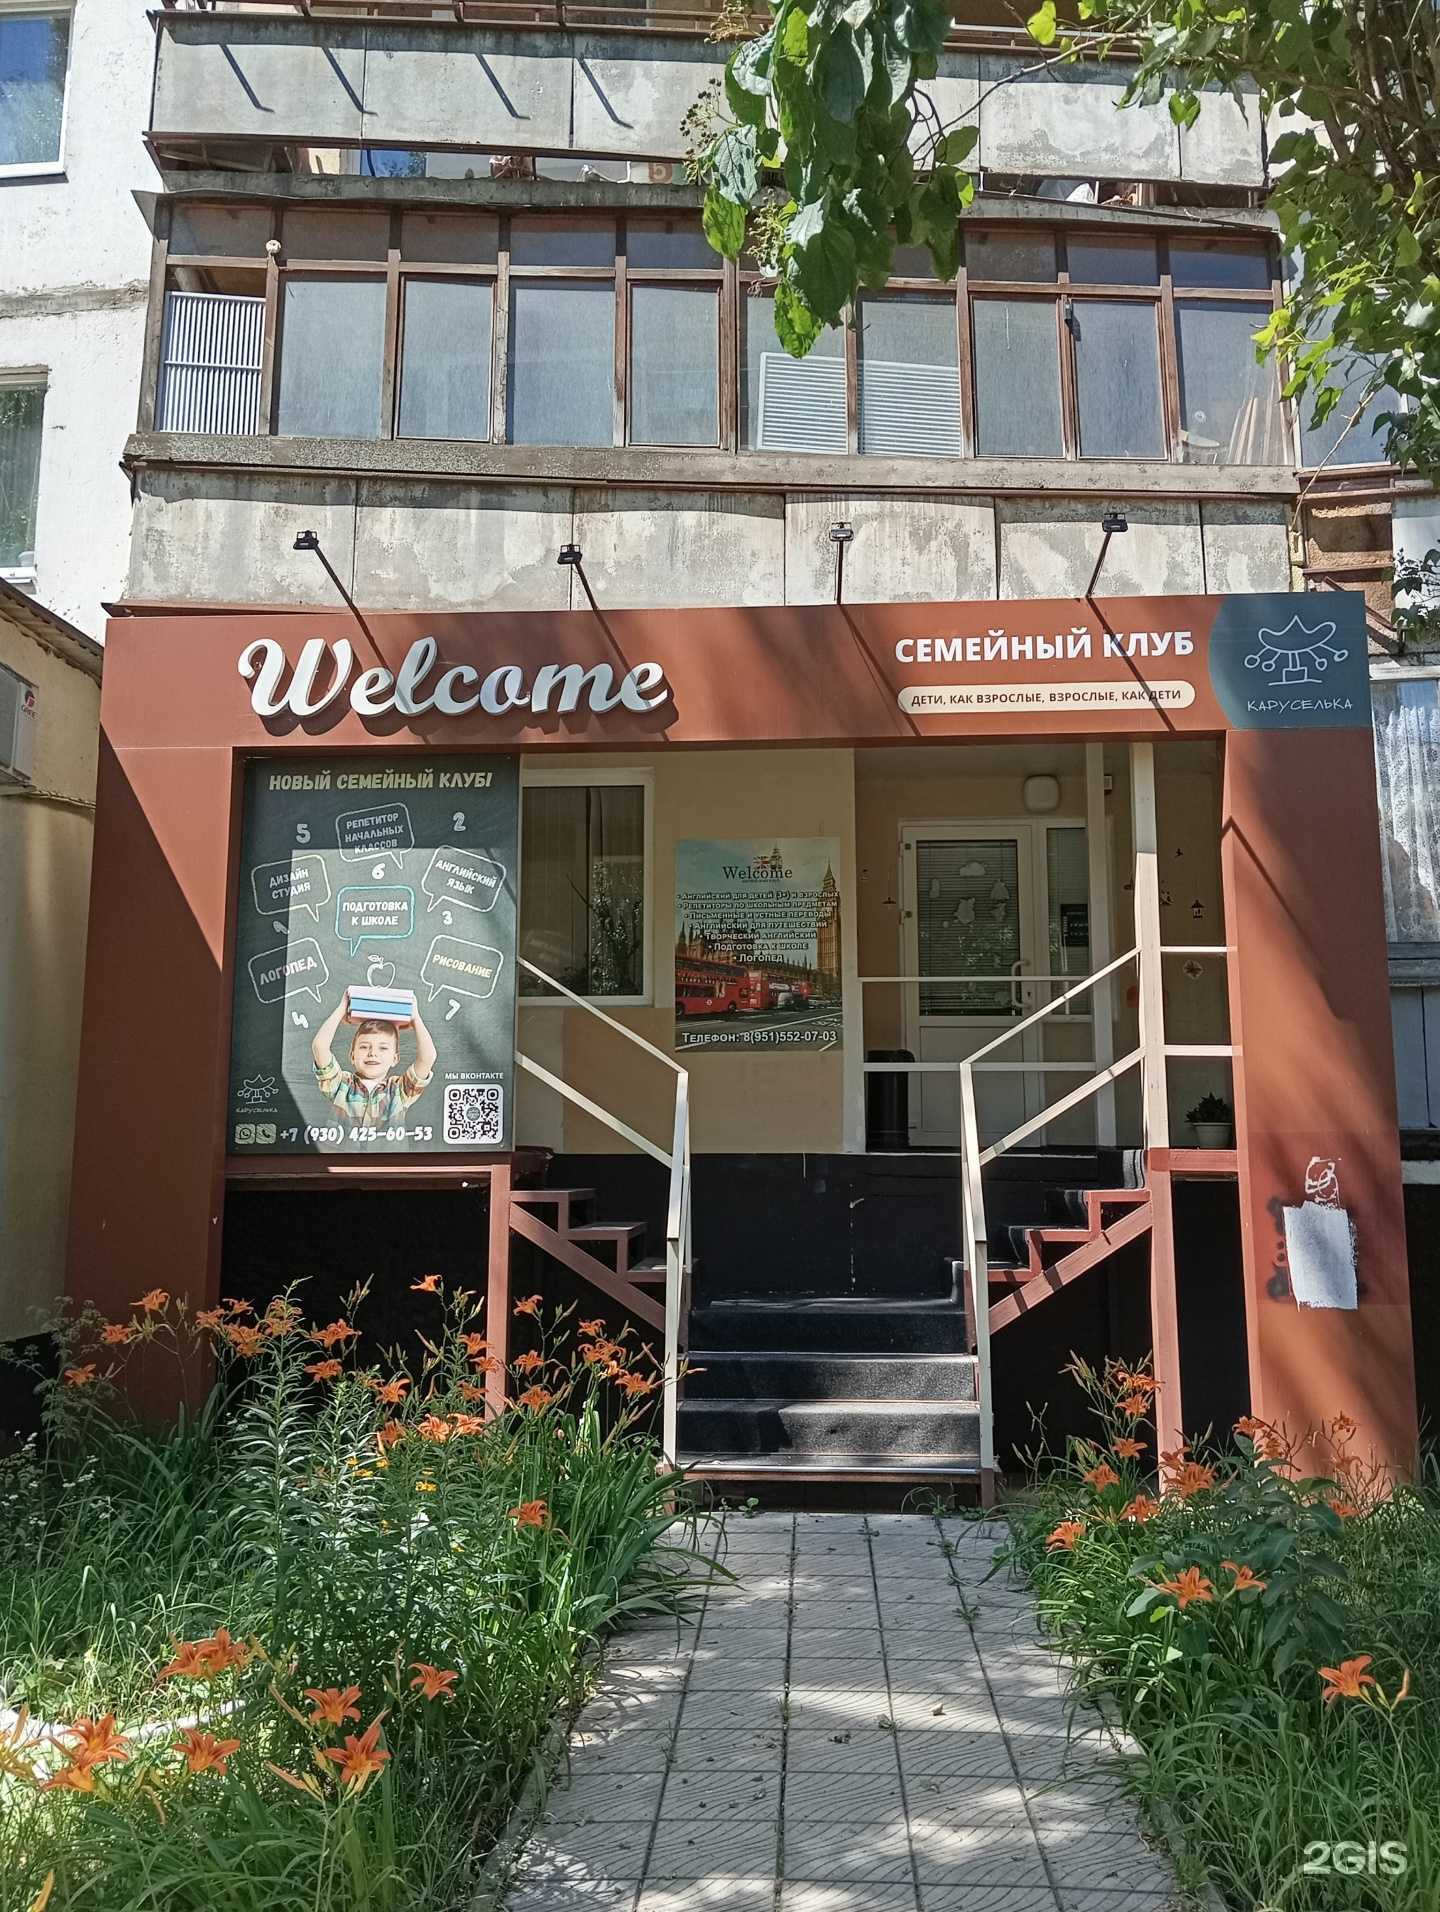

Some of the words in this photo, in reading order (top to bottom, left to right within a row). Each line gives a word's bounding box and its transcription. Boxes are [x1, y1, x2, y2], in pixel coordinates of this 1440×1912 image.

[895, 627, 1092, 663] СЕМЕЙНЫЙ
[1103, 630, 1195, 657] КЛУБ
[237, 636, 668, 717] Welcome
[911, 694, 947, 707] ДЕТИ,
[950, 693, 974, 705] КАК
[976, 692, 1046, 705] ВЗРОСЛЫЕ,
[1049, 691, 1119, 704] ВЗРОСЛЫЕ,
[1122, 690, 1146, 703] КАК
[1149, 689, 1181, 702] ДЕТИ
[1247, 699, 1353, 714] КАРУСЕЛЬКА
[269, 769, 331, 790] НОВЫЙ
[336, 769, 434, 789] СЕМЕЙНЫЙ
[346, 812, 399, 830] РЕПЕТИТОР
[453, 812, 466, 832] 2
[296, 823, 311, 843] 5
[344, 824, 404, 843] НАЧАЛЬНЫХ
[354, 838, 398, 855] КЛАССОВ
[269, 868, 310, 888] ДИЗАЙН
[371, 863, 386, 880] 6
[435, 859, 497, 889] АНГЛИЙСКИЙ
[722, 866, 793, 880] Welcome
[272, 881, 311, 900] СТУДИЯ
[446, 878, 474, 895] ЯЗЫК
[342, 900, 408, 913] ПОДГОТОВКА
[351, 916, 359, 926] К
[361, 915, 399, 926] ШКОЛЕ
[442, 911, 453, 926] 3
[259, 956, 318, 986] ЛОГОПЕД
[432, 953, 493, 979] РИСОВАНИЕ
[445, 999, 461, 1021] 7
[291, 1011, 309, 1029] 4
[445, 1072, 459, 1080] МЫ
[460, 1072, 504, 1080] ВКОНТАКТЕ
[280, 1127, 298, 1142] +7
[304, 1124, 344, 1145] (930)
[349, 1125, 433, 1142] 425-60-53
